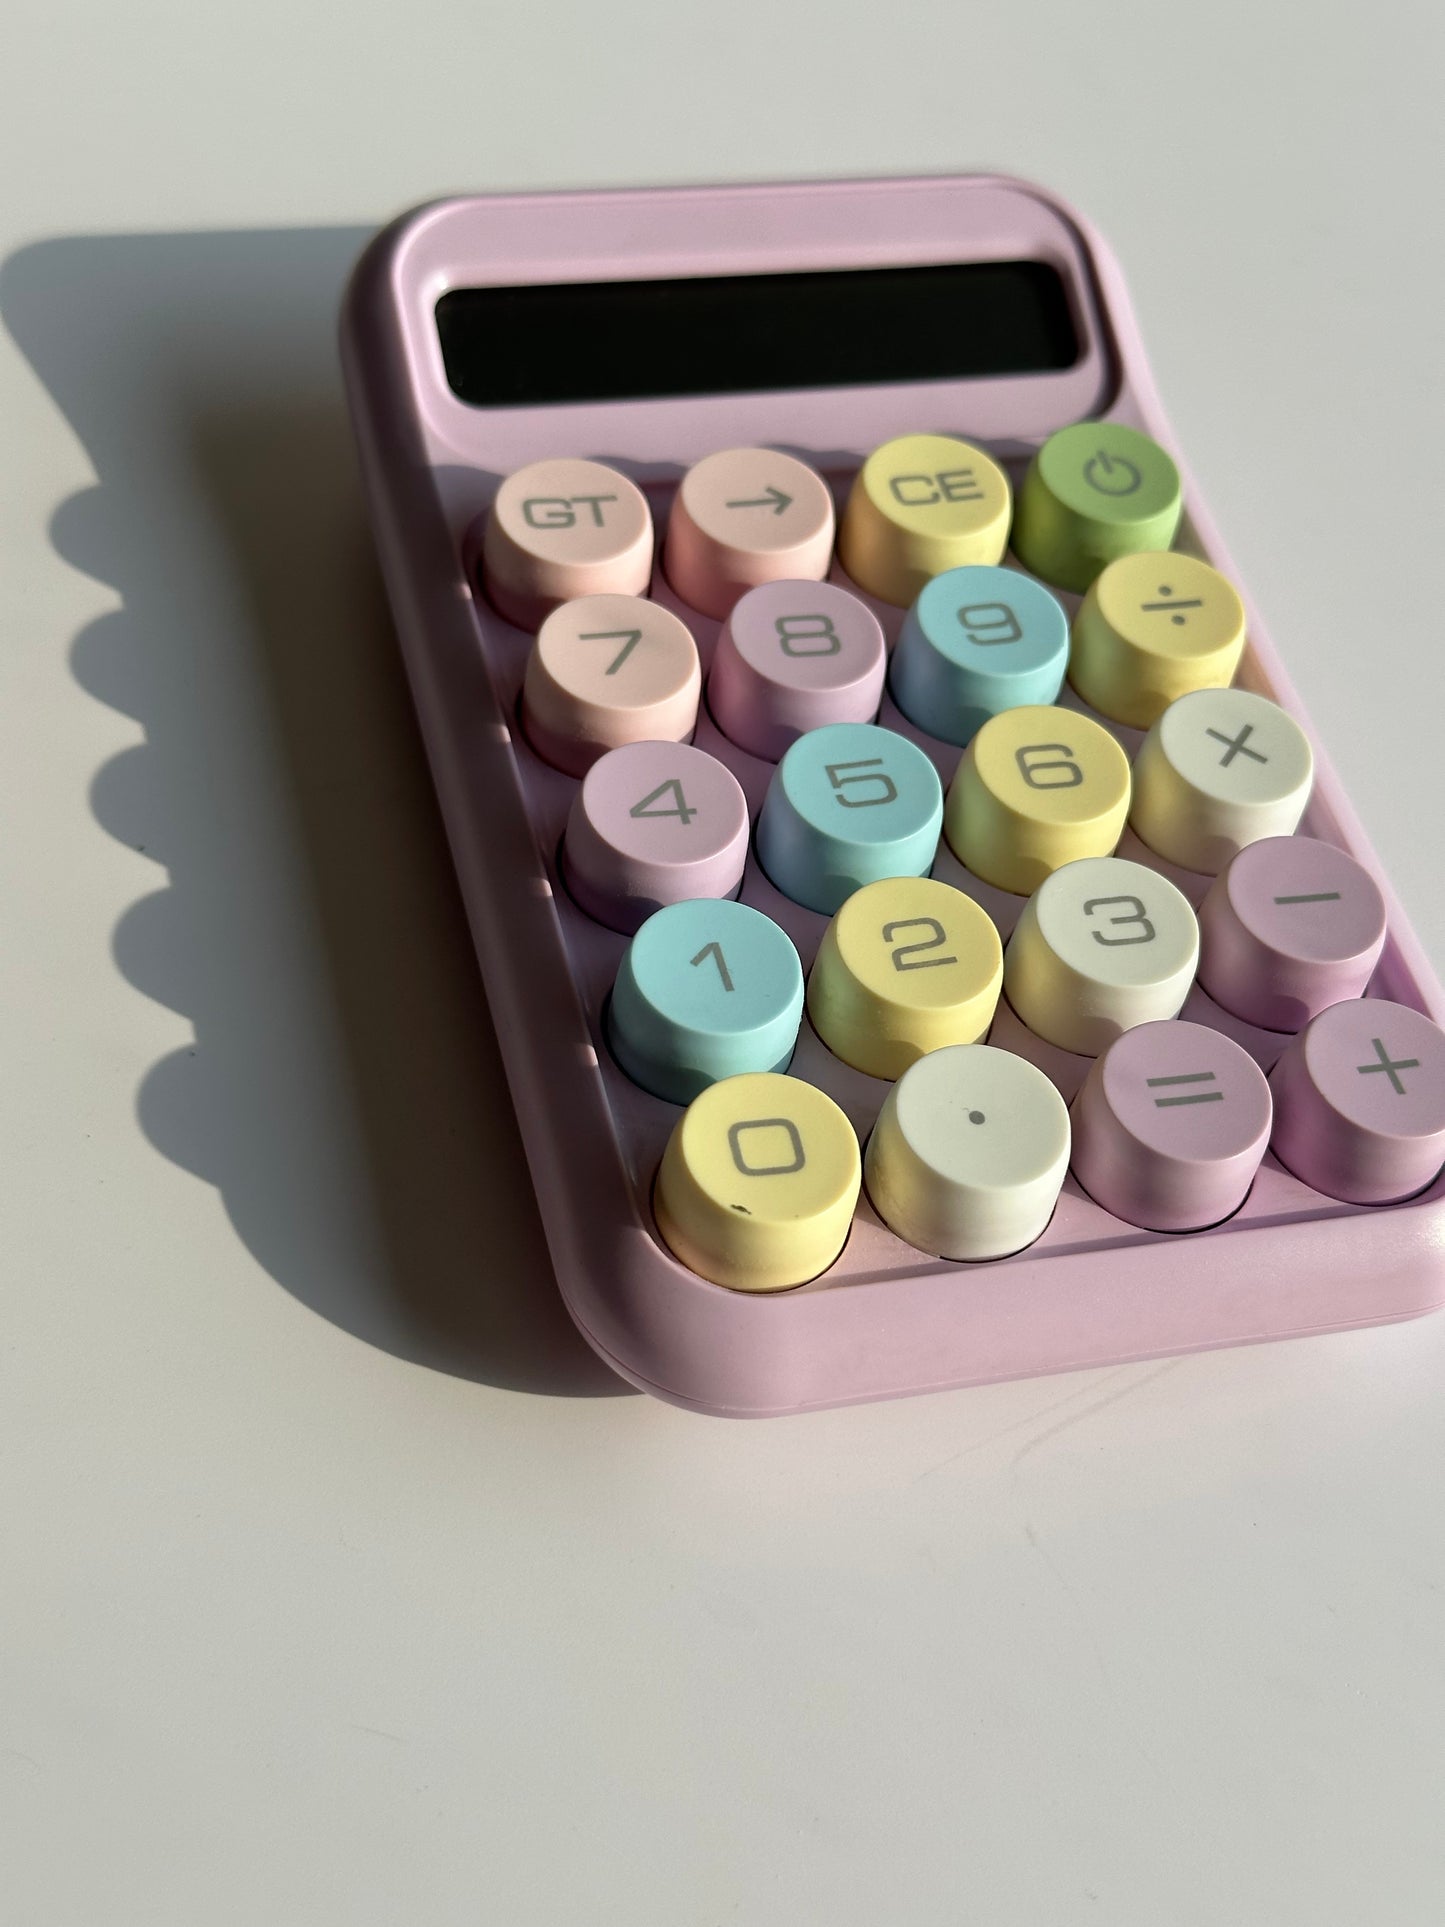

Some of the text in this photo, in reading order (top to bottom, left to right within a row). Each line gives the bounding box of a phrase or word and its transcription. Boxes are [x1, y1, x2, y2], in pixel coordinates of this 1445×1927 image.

[889, 469, 986, 507] CE
[523, 494, 619, 530] GT
[774, 615, 842, 658] 8
[957, 603, 1024, 647] 9
[579, 629, 644, 676] 7
[825, 759, 899, 809] 5
[1015, 744, 1084, 790] 6
[629, 779, 698, 826] 4
[883, 918, 959, 972] 2
[1084, 896, 1157, 947] 3
[690, 942, 735, 993] 1
[1357, 1039, 1421, 1096] +
[728, 1118, 806, 1177] 0
